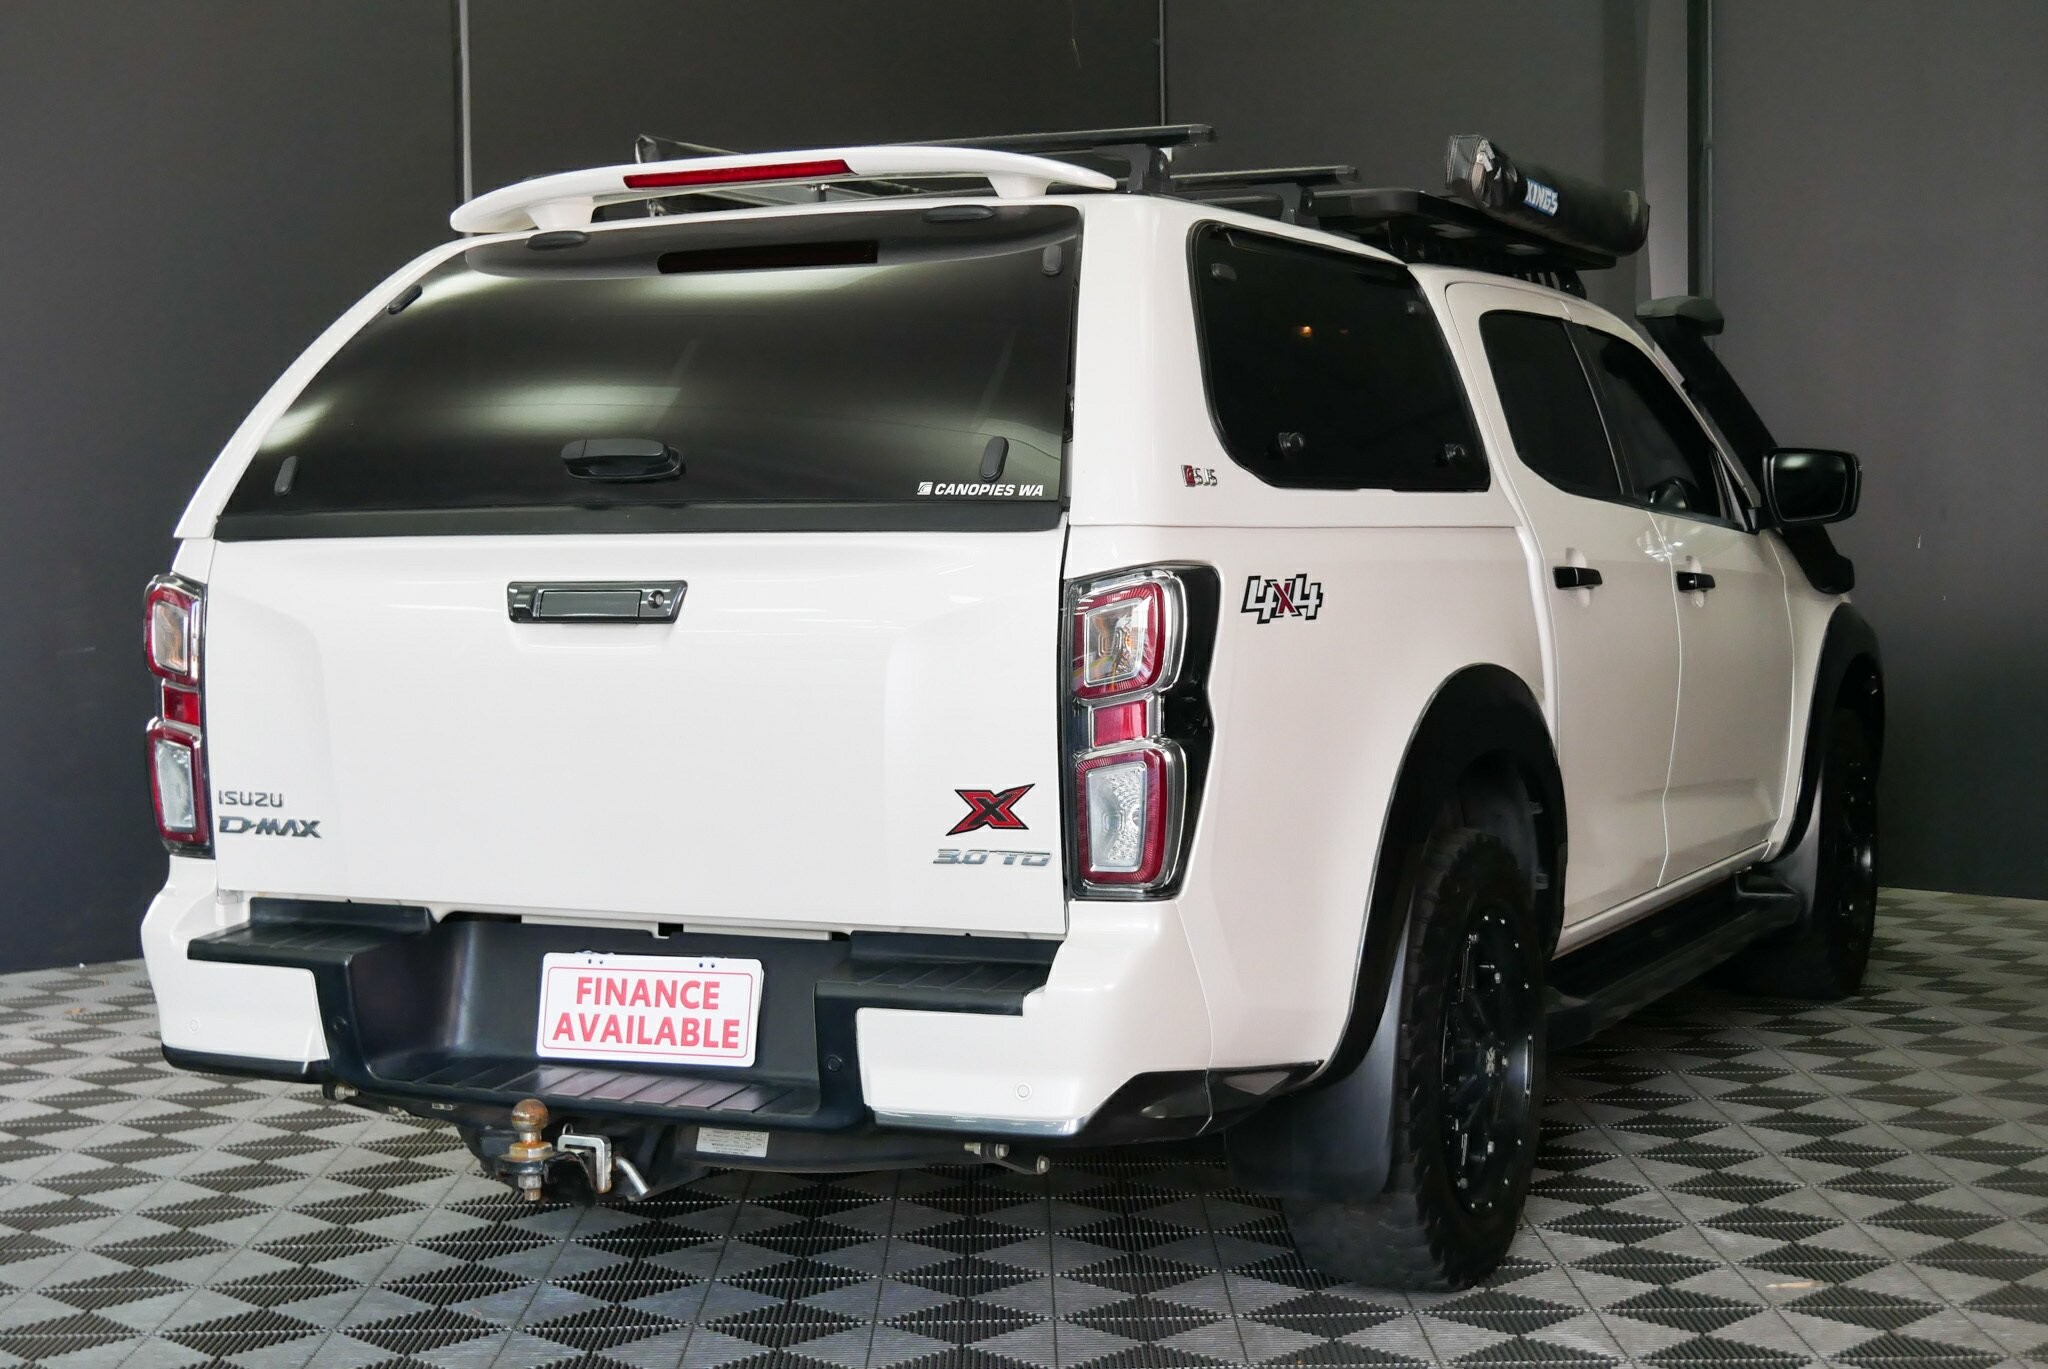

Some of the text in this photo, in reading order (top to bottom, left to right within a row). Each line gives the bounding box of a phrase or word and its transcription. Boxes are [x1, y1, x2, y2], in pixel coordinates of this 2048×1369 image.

[934, 483, 1043, 497] CANOPIES WA
[218, 789, 283, 808] ISUZU
[218, 815, 322, 839] D-MAX
[575, 976, 721, 1010] FINANCE
[552, 1012, 740, 1049] AVAILABLE
